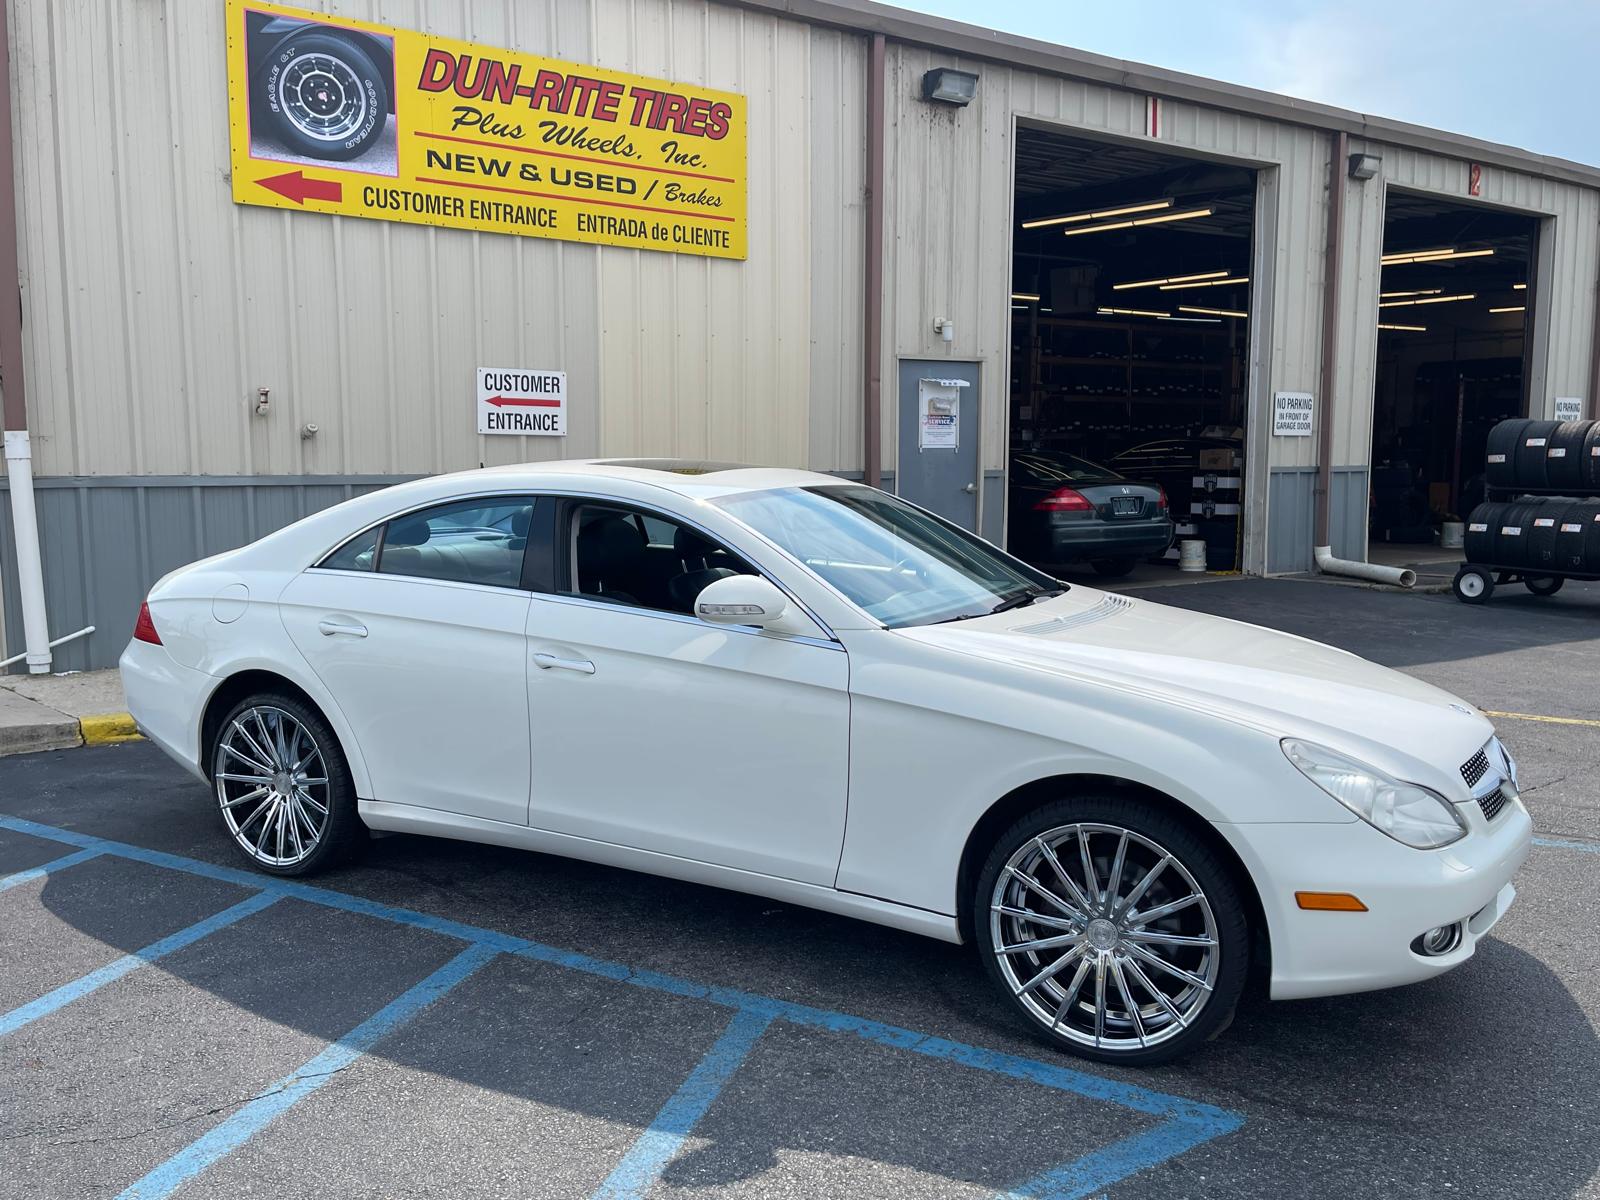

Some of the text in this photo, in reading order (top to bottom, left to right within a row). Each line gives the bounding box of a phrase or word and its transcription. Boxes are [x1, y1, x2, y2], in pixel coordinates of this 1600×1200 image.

[268, 47, 295, 112] EAGLE GT
[417, 48, 732, 140] DUN-RITE TIRES
[345, 80, 377, 148] GOODYEAR
[451, 106, 526, 139] Plus
[661, 140, 708, 169] Inc.
[427, 149, 723, 208] NEW & USED / Brakes
[1472, 163, 1480, 196] 2
[363, 186, 557, 228] CUSTOMER ENTRANCE
[577, 213, 729, 248] ENTRADA de CLIENTE
[484, 373, 560, 393] CUSTOMER
[487, 412, 559, 431] ENTRANCE
[1277, 398, 1312, 410] NO PARKING
[1286, 413, 1301, 421] FRONT
